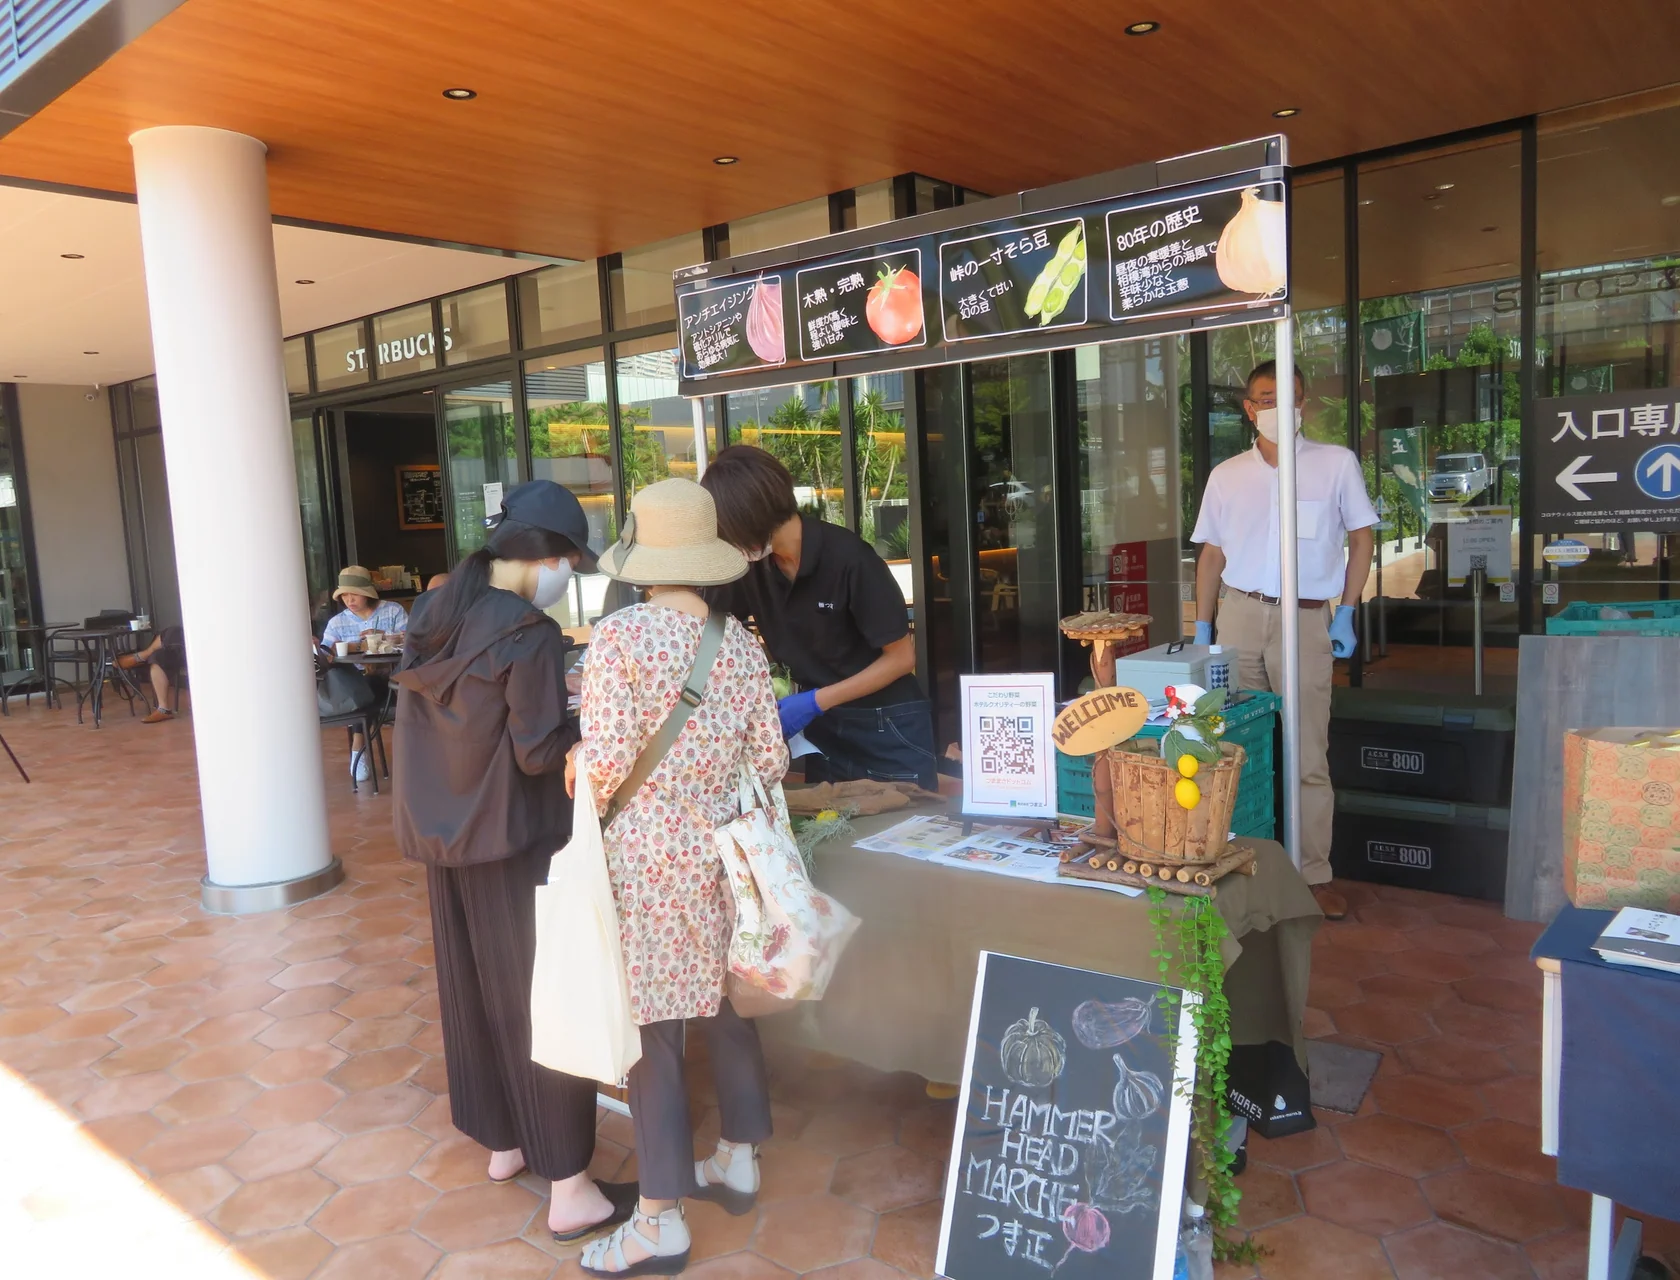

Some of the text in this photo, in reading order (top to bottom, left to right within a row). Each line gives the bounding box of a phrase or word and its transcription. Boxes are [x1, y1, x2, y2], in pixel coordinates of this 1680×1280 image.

[1117, 206, 1202, 251] 80年の歴史
[949, 229, 1051, 282] 峠の一寸そら豆
[683, 283, 756, 330] アンチエイジング
[802, 271, 866, 309] 木熟・完熟
[957, 279, 1014, 310] 大きくて甘い
[959, 300, 991, 321] 幻の豆
[345, 326, 454, 373] STRBUCKS
[1052, 691, 1139, 746] WELCOME
[1393, 753, 1420, 771] 800
[1399, 847, 1427, 866] 800
[981, 1085, 1116, 1148] HAMMER
[998, 1127, 1079, 1176] HEAD
[962, 1152, 1079, 1228] MARCHE
